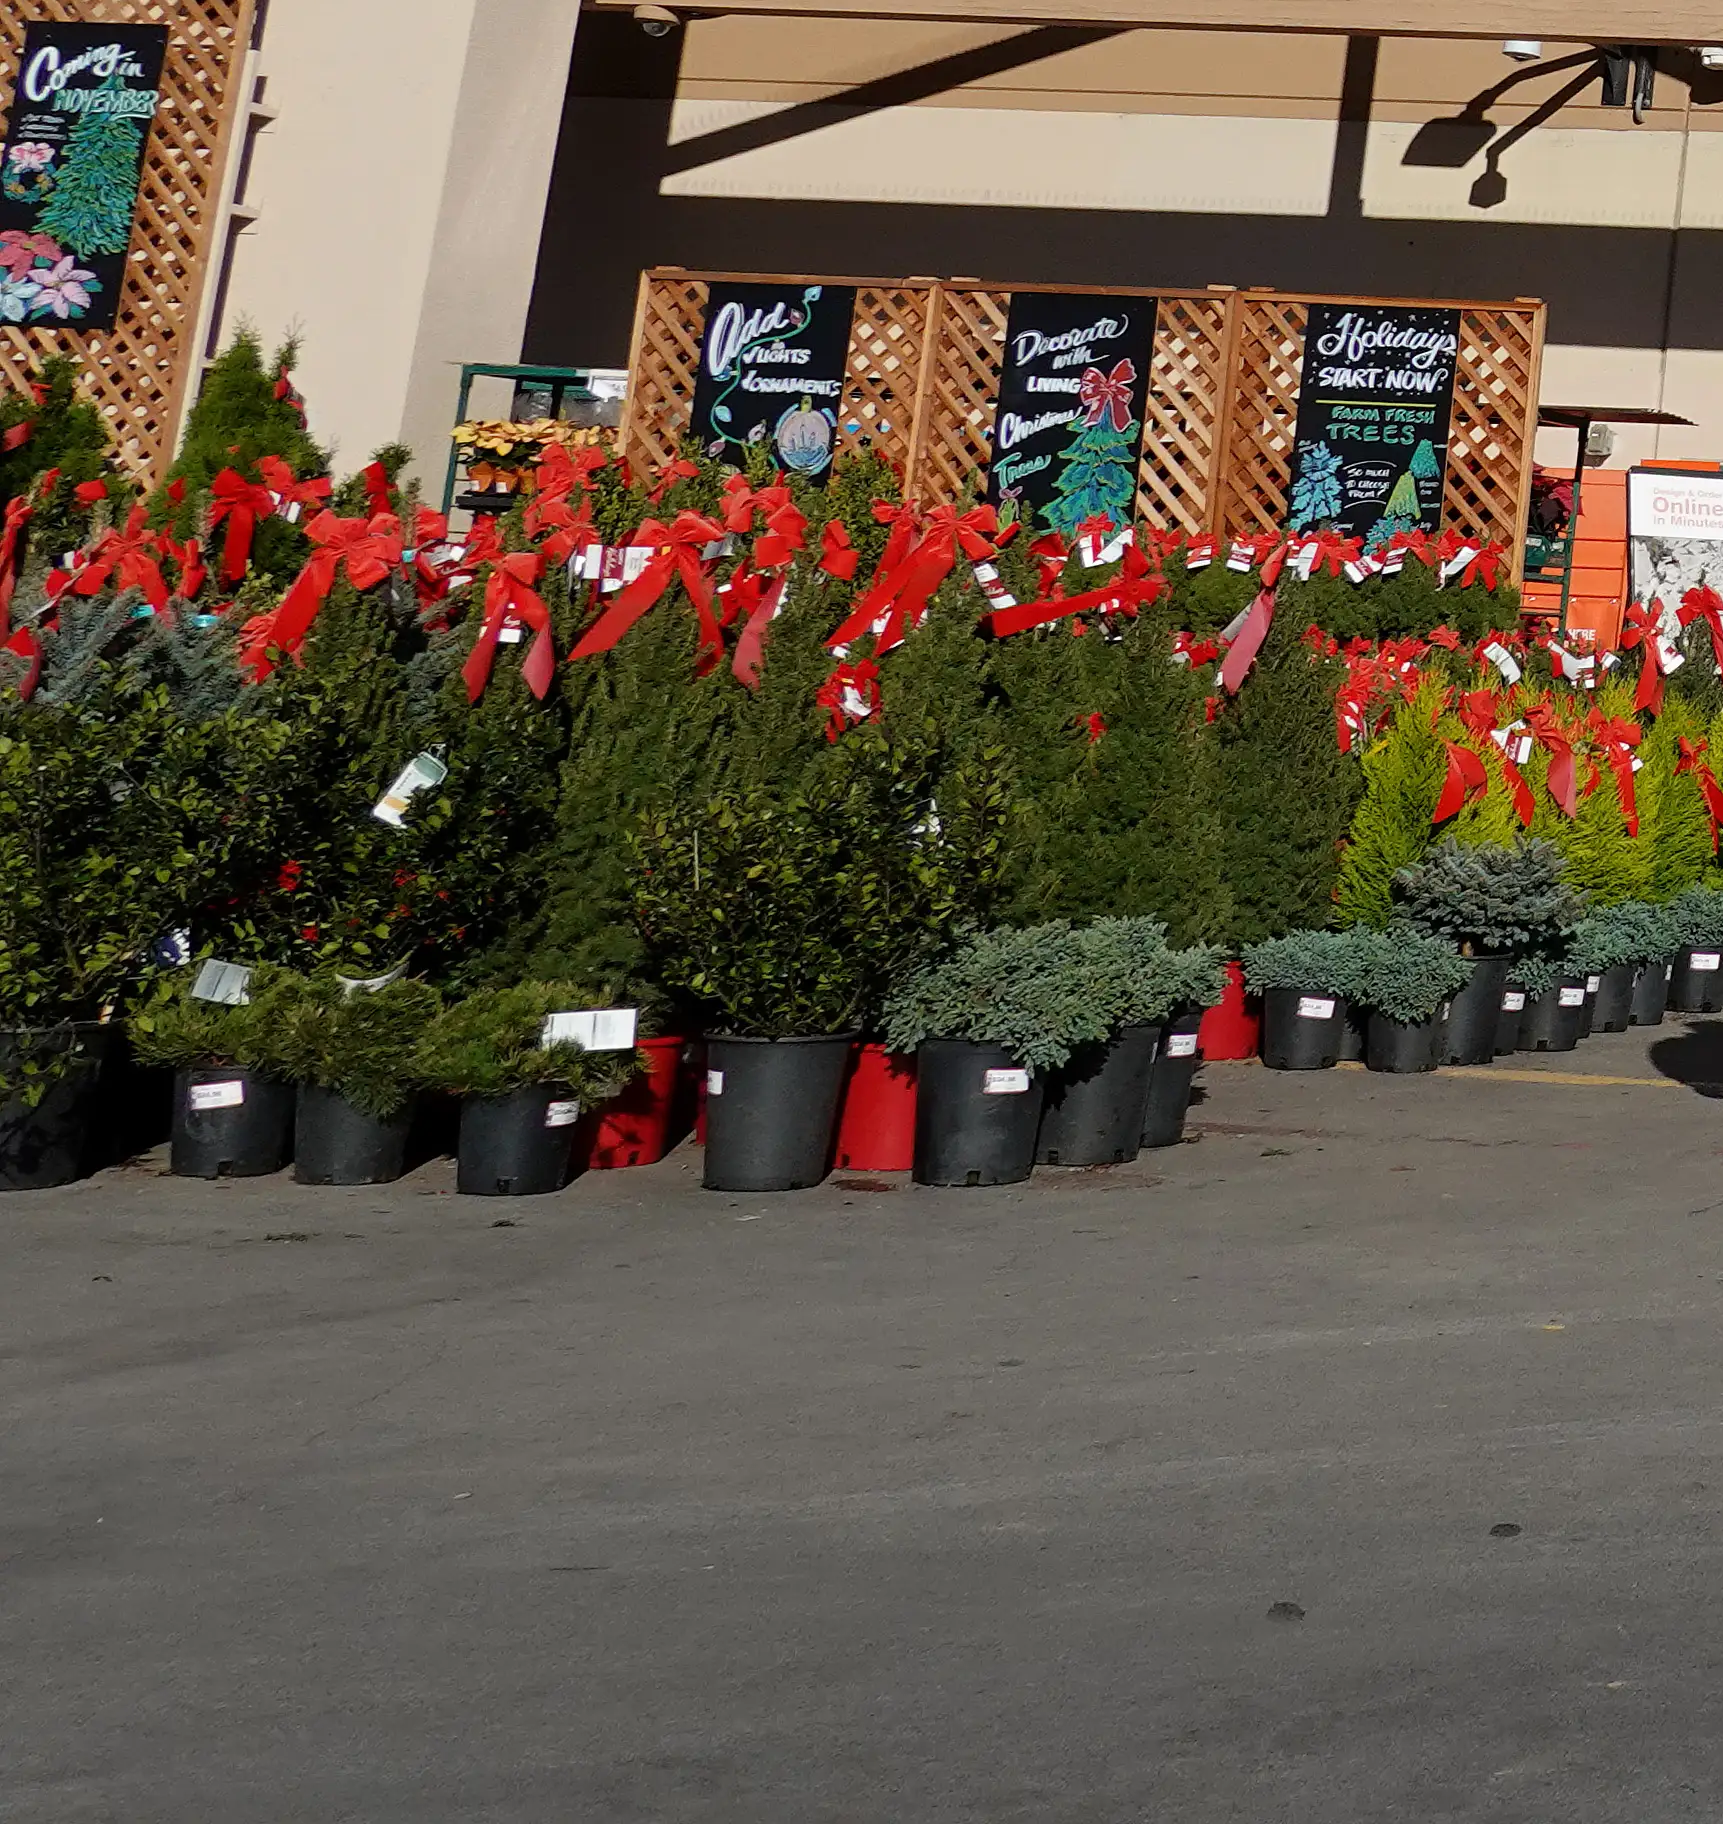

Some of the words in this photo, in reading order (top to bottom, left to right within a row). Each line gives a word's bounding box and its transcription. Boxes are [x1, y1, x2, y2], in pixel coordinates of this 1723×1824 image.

[25, 43, 137, 102] Coming
[118, 57, 146, 77] in
[52, 89, 160, 117] NOVEMBER
[1012, 314, 1129, 367] Decorate
[1317, 313, 1457, 369] Holidays
[757, 346, 811, 364] LIGHTS
[1052, 348, 1110, 370] with
[749, 376, 843, 397] ORNAMENTS
[1027, 376, 1081, 394] LIVING
[1319, 366, 1383, 389] START
[1384, 368, 1448, 393] NOW
[1332, 406, 1380, 421] FARM
[1385, 407, 1436, 425] FRESH
[1000, 406, 1083, 449] Christmas
[1326, 423, 1415, 445] TREES
[993, 452, 1052, 489] Trees
[1653, 486, 1687, 499] Design
[1688, 489, 1695, 497] &
[1697, 489, 1723, 499] Order
[1653, 515, 1666, 526] in
